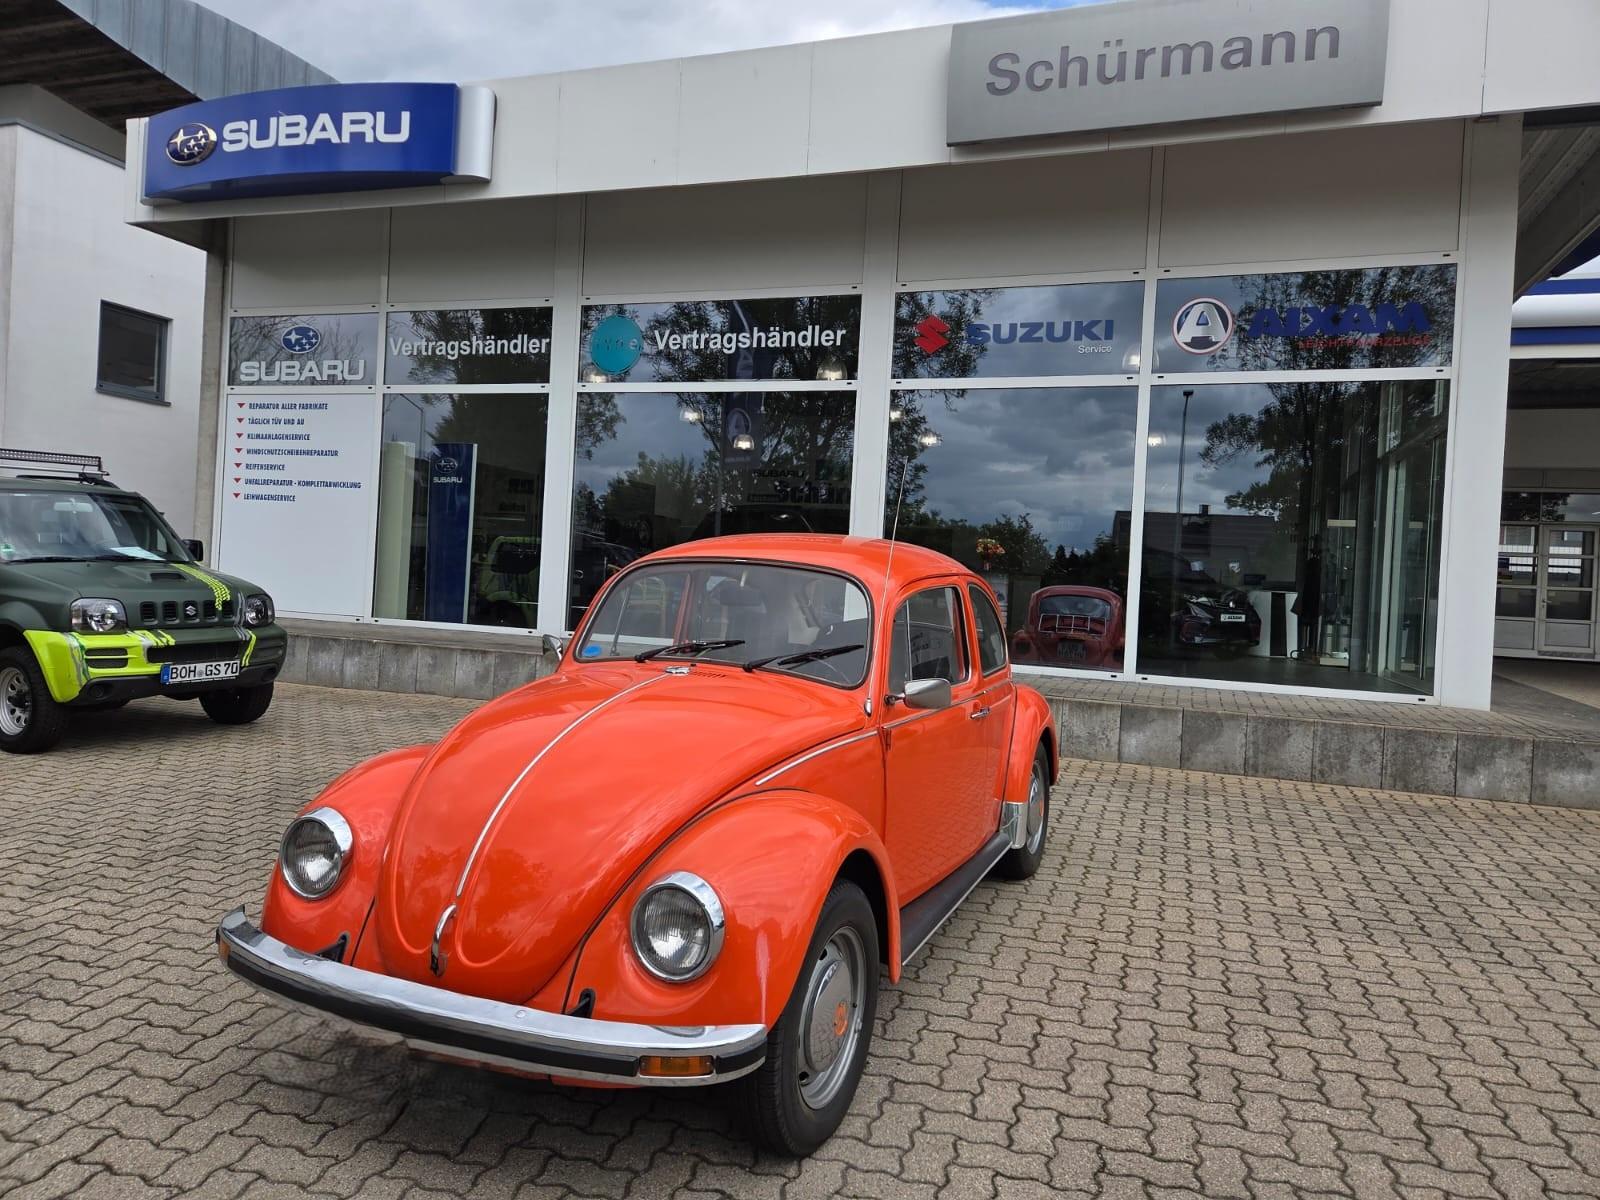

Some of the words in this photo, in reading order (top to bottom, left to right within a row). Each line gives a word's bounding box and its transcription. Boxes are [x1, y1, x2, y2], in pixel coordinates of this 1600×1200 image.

[985, 24, 1340, 97] Schürmann
[222, 110, 411, 153] SUBARU
[1248, 302, 1432, 338] AIXAM
[965, 319, 1115, 345] SUZUKI
[653, 325, 847, 354] Vertragshändler
[389, 334, 550, 360] Vertragshändler
[1078, 344, 1112, 354] Service
[239, 359, 365, 382] SUBARU
[248, 402, 280, 410] REPARATUR
[281, 402, 297, 410] ALLER
[248, 417, 270, 425] TÄGLICH
[271, 417, 282, 425] TÜV
[296, 418, 305, 426] AU
[247, 433, 310, 441] KLIMAANLAGENSERVICE
[246, 448, 339, 457] WINDSCHUTZSCHEIBENREPARATUR
[245, 463, 285, 471] REIFENSERVICE
[244, 478, 293, 487] UNFALLREPARATUR
[297, 479, 362, 489] KOMPLETTABWICKLUNG
[243, 493, 296, 502] LEIHWAGENSERVICE
[170, 666, 197, 679] BOH
[205, 664, 221, 677] GS
[223, 662, 238, 675] 70
